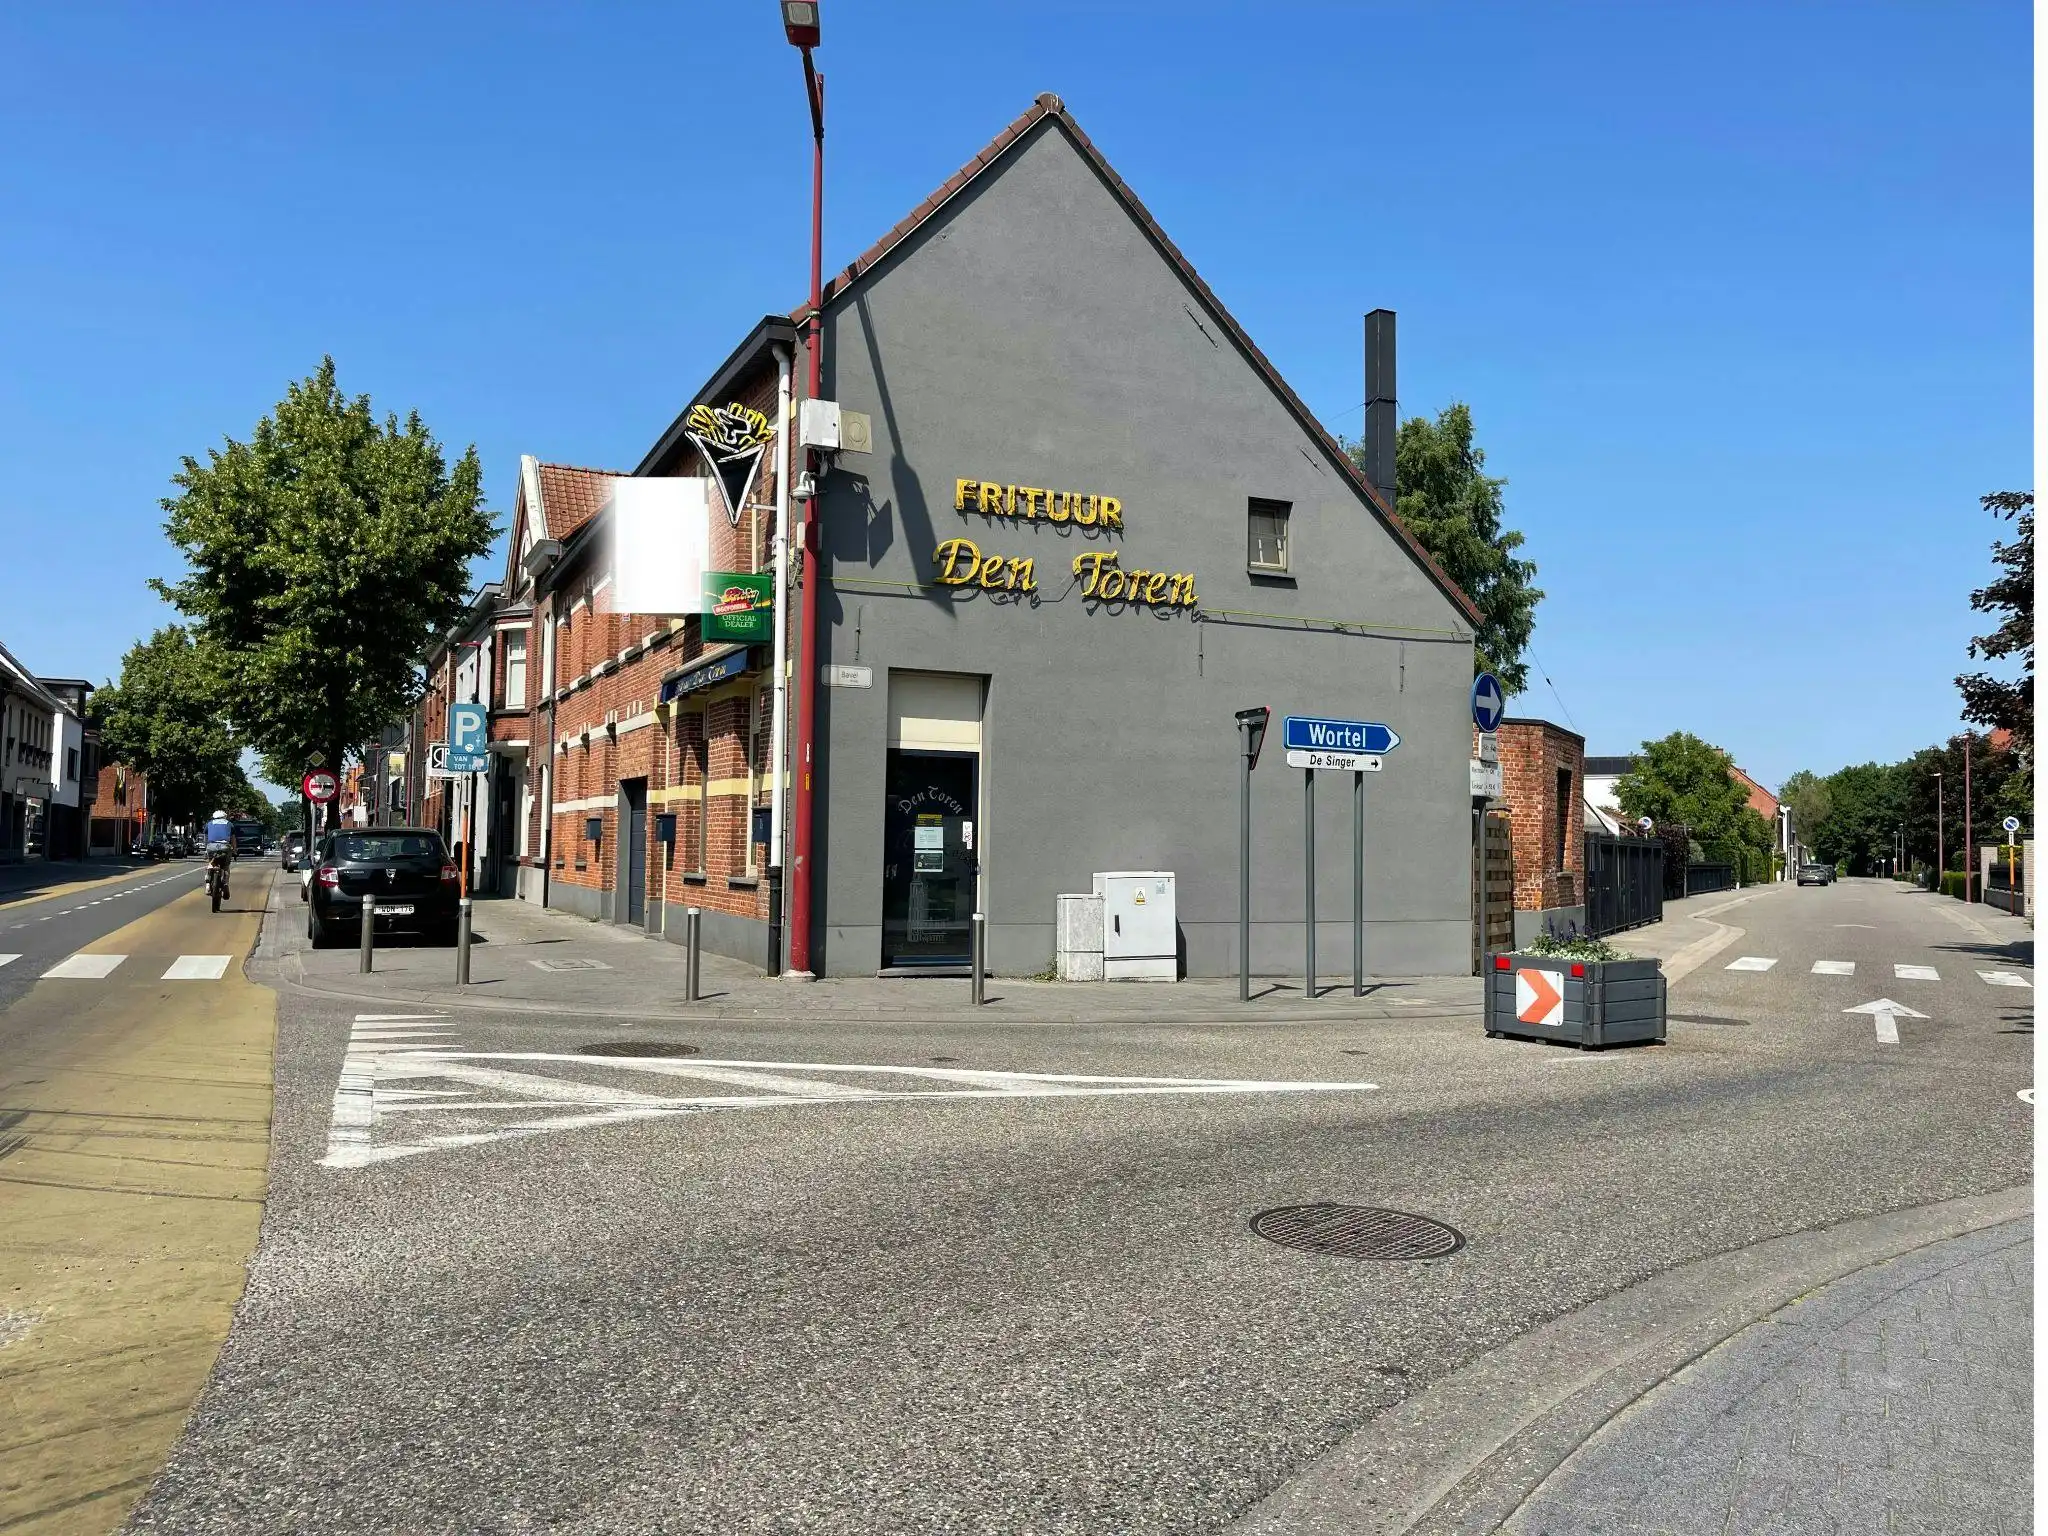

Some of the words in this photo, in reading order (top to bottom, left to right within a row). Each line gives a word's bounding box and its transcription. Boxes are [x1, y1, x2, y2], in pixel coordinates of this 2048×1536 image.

[954, 478, 1124, 528] FRITUUR
[932, 537, 1038, 591] Den
[1072, 550, 1199, 605] Toren
[722, 614, 757, 622] OFFICIAL
[724, 620, 754, 628] DEALER
[455, 711, 481, 746] P
[1309, 723, 1366, 748] Wortel
[1310, 754, 1322, 766] De
[1326, 756, 1356, 769] Singer
[898, 791, 926, 815] Den
[927, 785, 964, 815] Toren
